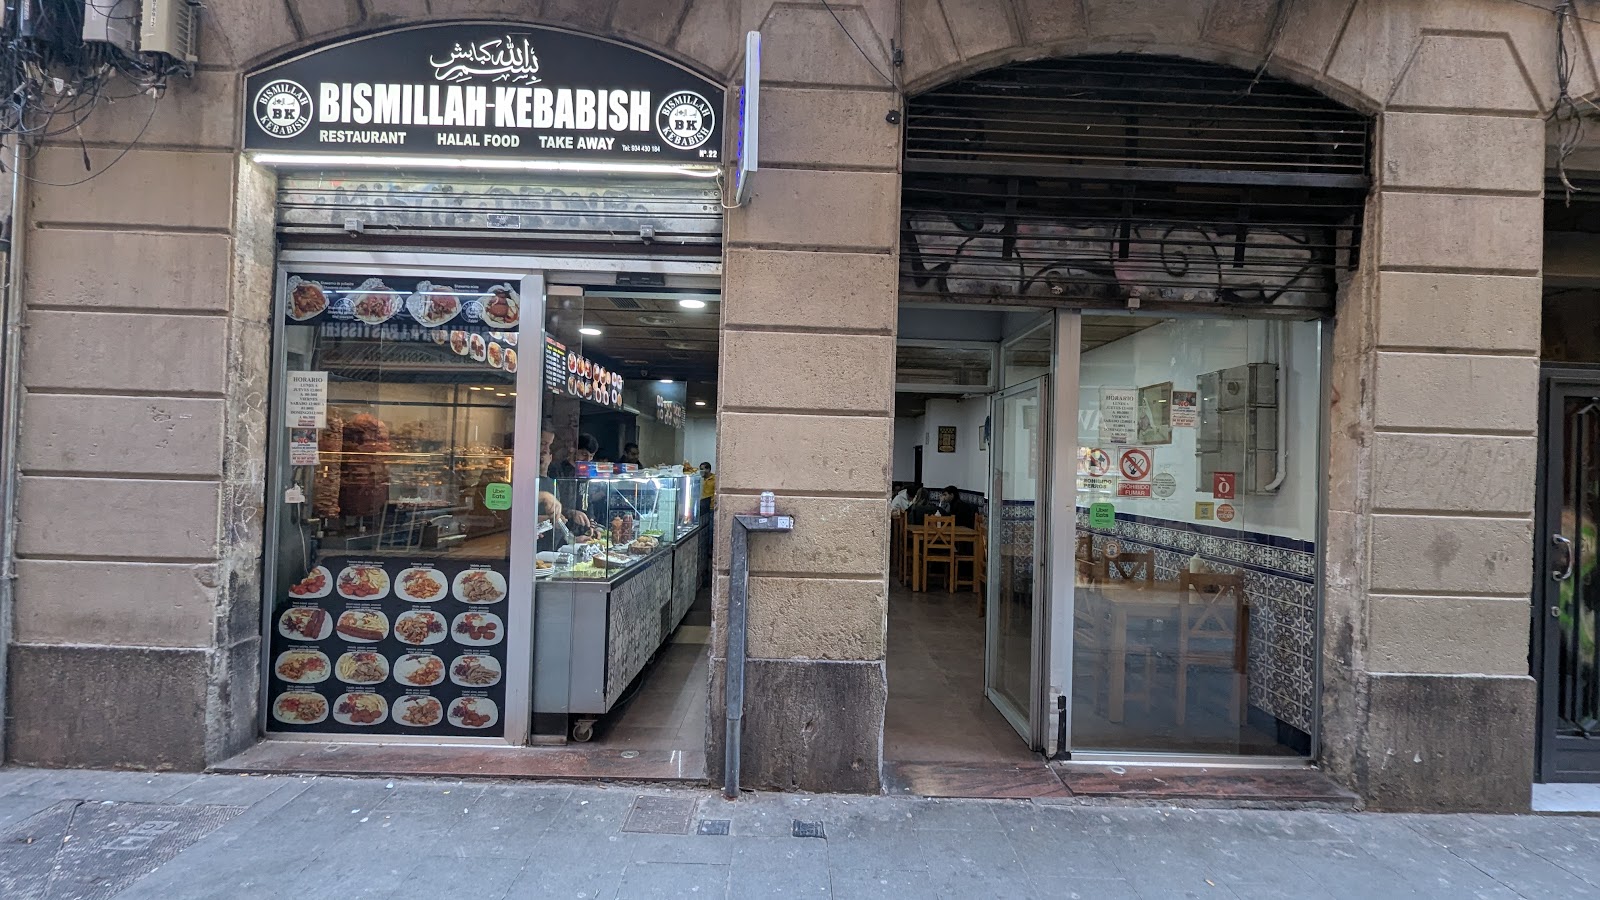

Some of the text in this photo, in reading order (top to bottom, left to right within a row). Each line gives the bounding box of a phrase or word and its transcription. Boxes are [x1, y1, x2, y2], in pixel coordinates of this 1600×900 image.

[259, 84, 309, 106] BISMILLAH
[661, 95, 711, 117] BISMILLAH
[260, 115, 308, 135] KEBABISH
[319, 130, 616, 150] RESTAURANT HALAL FOOD TAKE AWAY
[662, 126, 710, 146] KEBABISH
